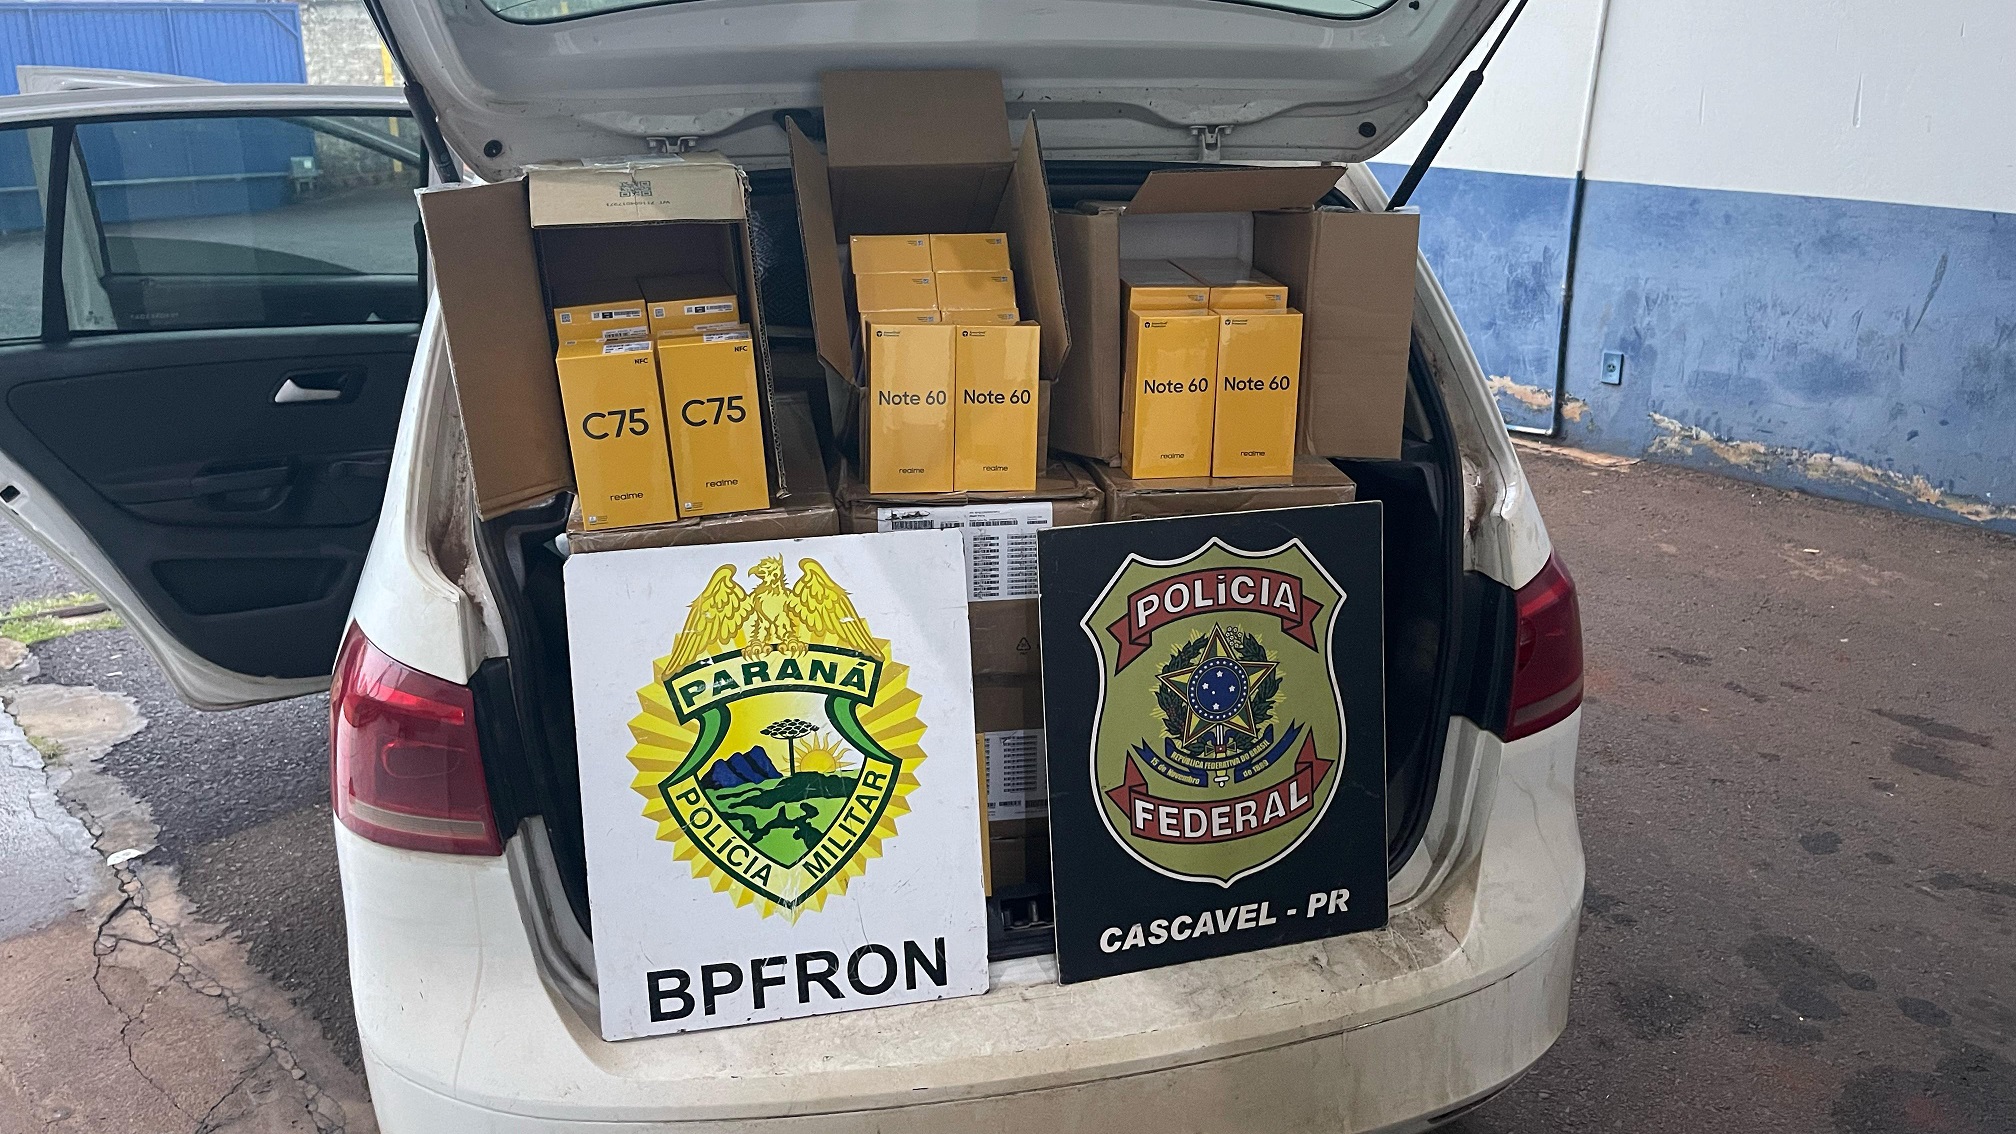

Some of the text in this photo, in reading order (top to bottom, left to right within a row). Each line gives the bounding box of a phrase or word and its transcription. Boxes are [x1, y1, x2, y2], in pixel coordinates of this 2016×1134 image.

[964, 389, 1031, 405] Note 60
[1144, 378, 1208, 394] Note 60
[1224, 375, 1290, 392] Note 60
[681, 395, 746, 427] C75
[878, 390, 947, 406] Note 60
[582, 407, 649, 440] C75
[982, 464, 1008, 472] realme
[610, 491, 644, 501] realme
[705, 478, 738, 488] realme
[679, 658, 868, 708] PARANÁ
[1150, 757, 1200, 785] 15 de Novembro
[1134, 780, 1308, 838] FEDERAL
[676, 769, 888, 888] POLÍCIA MILITAR
[1099, 888, 1350, 953] CASCAVEL - PR
[646, 936, 948, 1023] BPFRON
